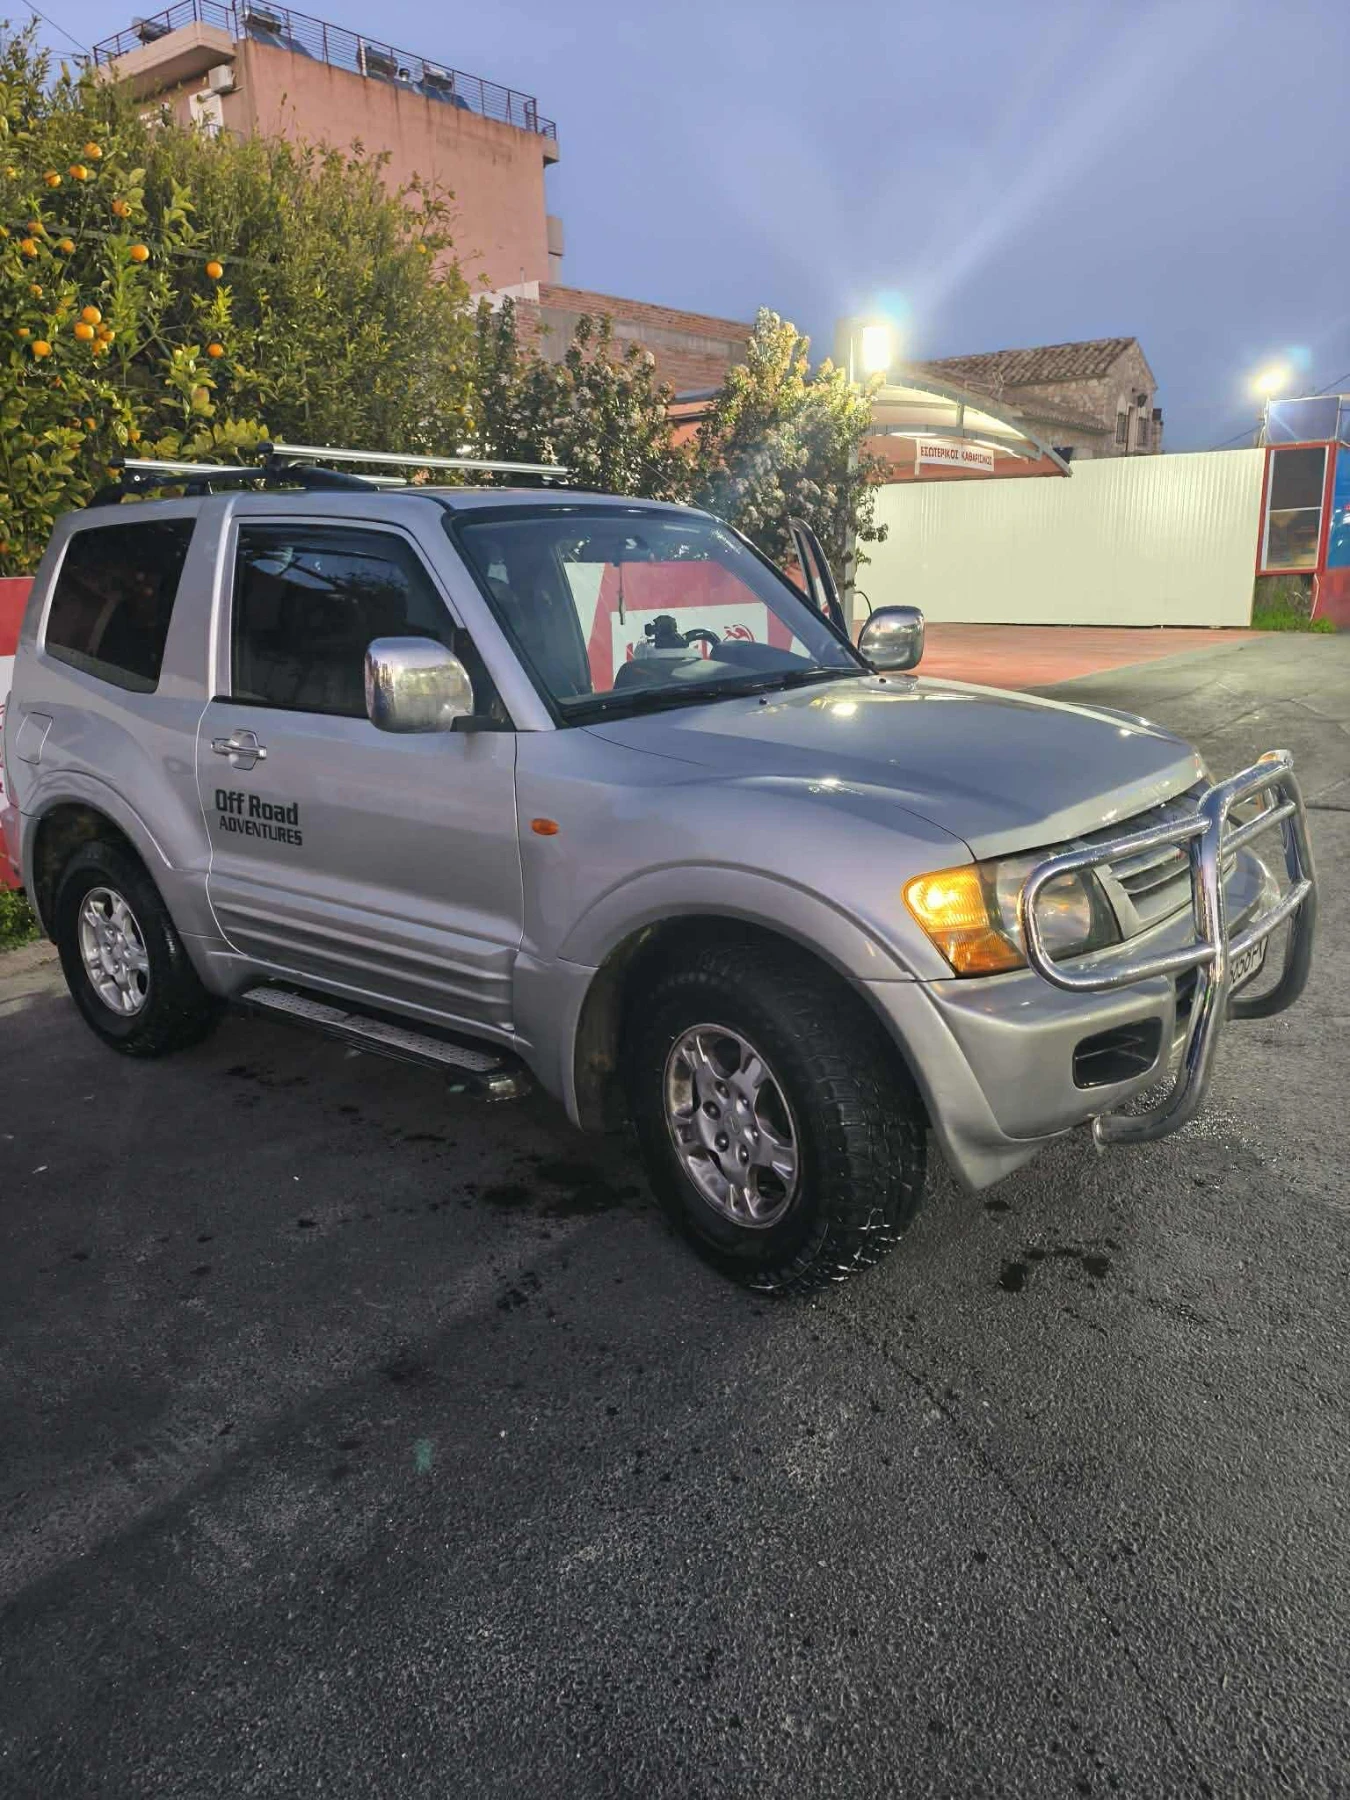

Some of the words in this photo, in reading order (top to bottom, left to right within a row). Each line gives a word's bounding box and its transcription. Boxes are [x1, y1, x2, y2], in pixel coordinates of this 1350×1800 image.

[920, 446, 959, 460] ΕΣΩΤΕΡΙΚΟΣ
[215, 789, 245, 815] Off
[248, 794, 299, 826] Road
[219, 815, 303, 846] ADVENTURES
